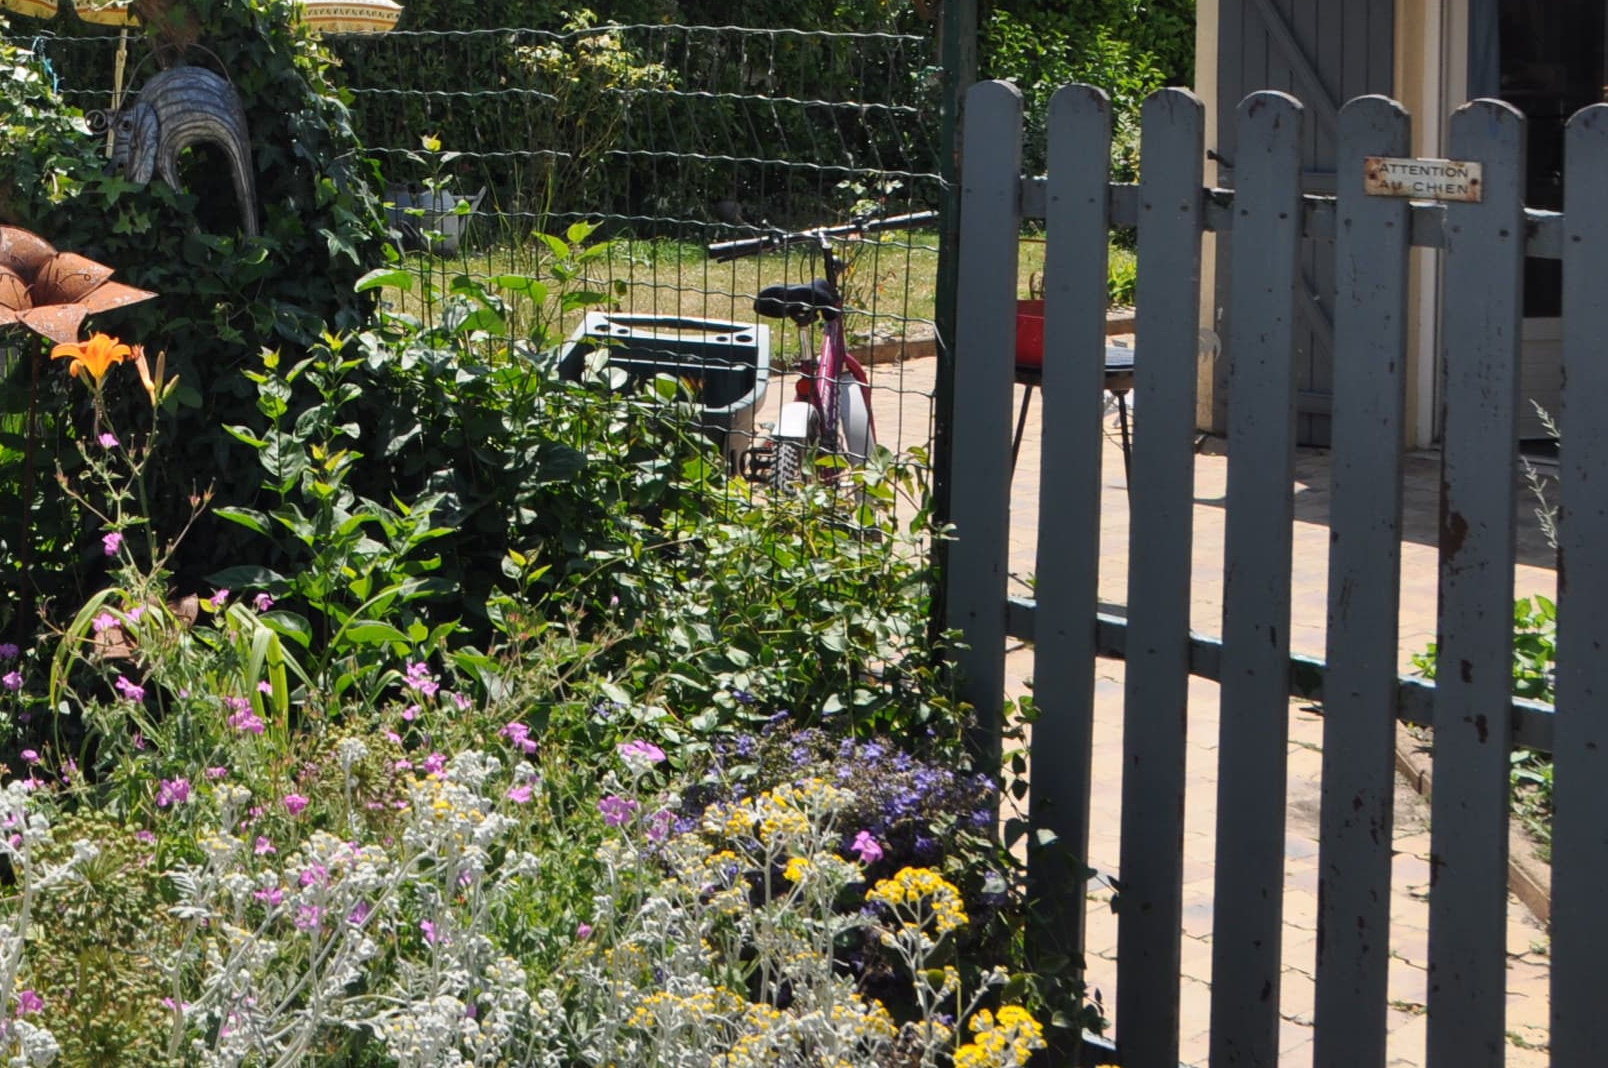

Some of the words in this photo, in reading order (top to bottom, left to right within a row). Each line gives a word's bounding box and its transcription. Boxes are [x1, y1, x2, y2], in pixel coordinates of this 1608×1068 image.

[1379, 163, 1469, 178] ATTENTION
[1379, 179, 1402, 191] AU
[1412, 181, 1469, 194] CHIEN
